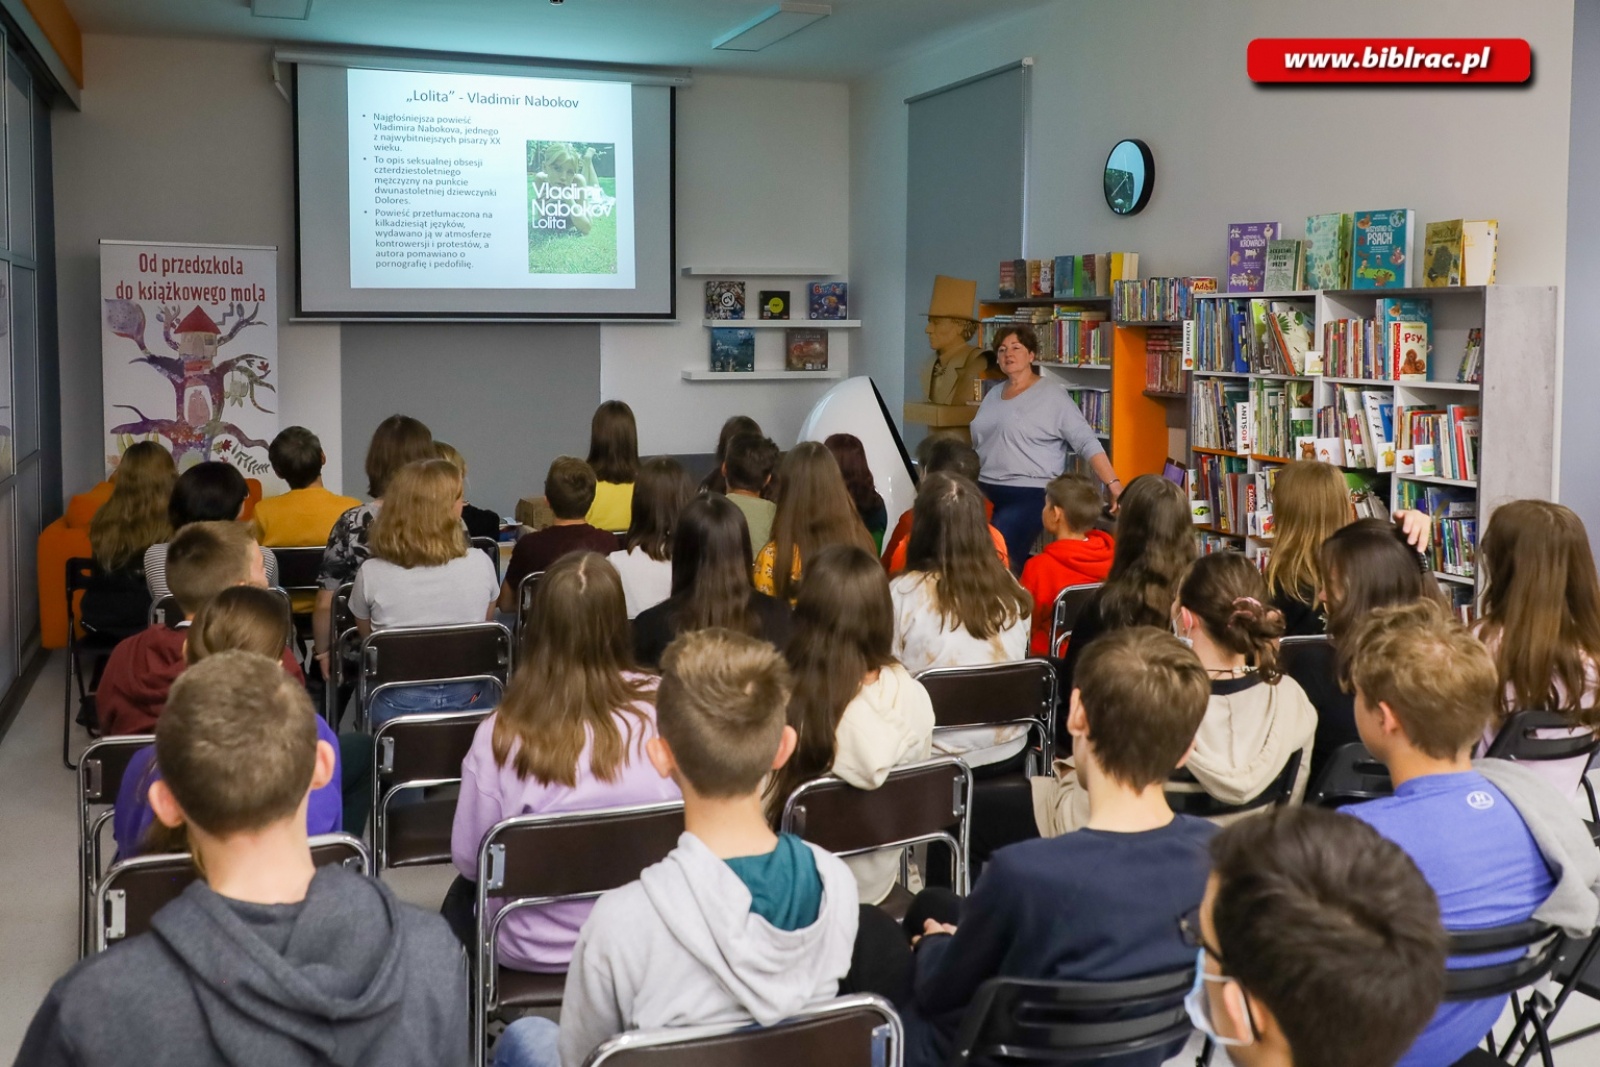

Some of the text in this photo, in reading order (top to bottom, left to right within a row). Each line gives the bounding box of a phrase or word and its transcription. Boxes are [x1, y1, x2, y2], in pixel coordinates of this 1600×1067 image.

[406, 90, 455, 103] „Lolita”
[467, 92, 521, 105] Vladimir
[525, 95, 579, 109] Nabokov
[373, 112, 472, 125] Najgłośniejsza powieść
[374, 123, 499, 136] Vladimira Nabokova, jednego
[380, 133, 456, 144] najwybitniejszych
[458, 137, 488, 146] pisarzy
[373, 143, 403, 152] wieku.
[374, 156, 483, 168] To opis seksualnej obsesji
[374, 167, 461, 177] czterdziestoletniego
[435, 178, 469, 187] punkcie
[374, 187, 497, 197] dwunastoletniej dziewczynki
[532, 182, 601, 201] Vladimir
[375, 196, 411, 205] Dolores.
[532, 199, 612, 217] Nabokov
[375, 209, 410, 217] Powieść
[412, 210, 480, 219] przetłumaczona
[375, 219, 466, 229] kilkadziesiąt języków,
[532, 217, 566, 229] Lolita
[375, 229, 423, 238] wydawano
[425, 231, 432, 239] ją
[445, 230, 492, 238] atmosferze
[1367, 232, 1392, 245] PSACH
[375, 240, 430, 249] kontrowersji
[437, 240, 482, 249] protestów,
[407, 251, 458, 259] pomawiano
[139, 253, 244, 277] Od przedszkola
[375, 260, 427, 269] pornografię
[434, 260, 474, 269] pedofilię.
[116, 281, 266, 305] do książkowego mola
